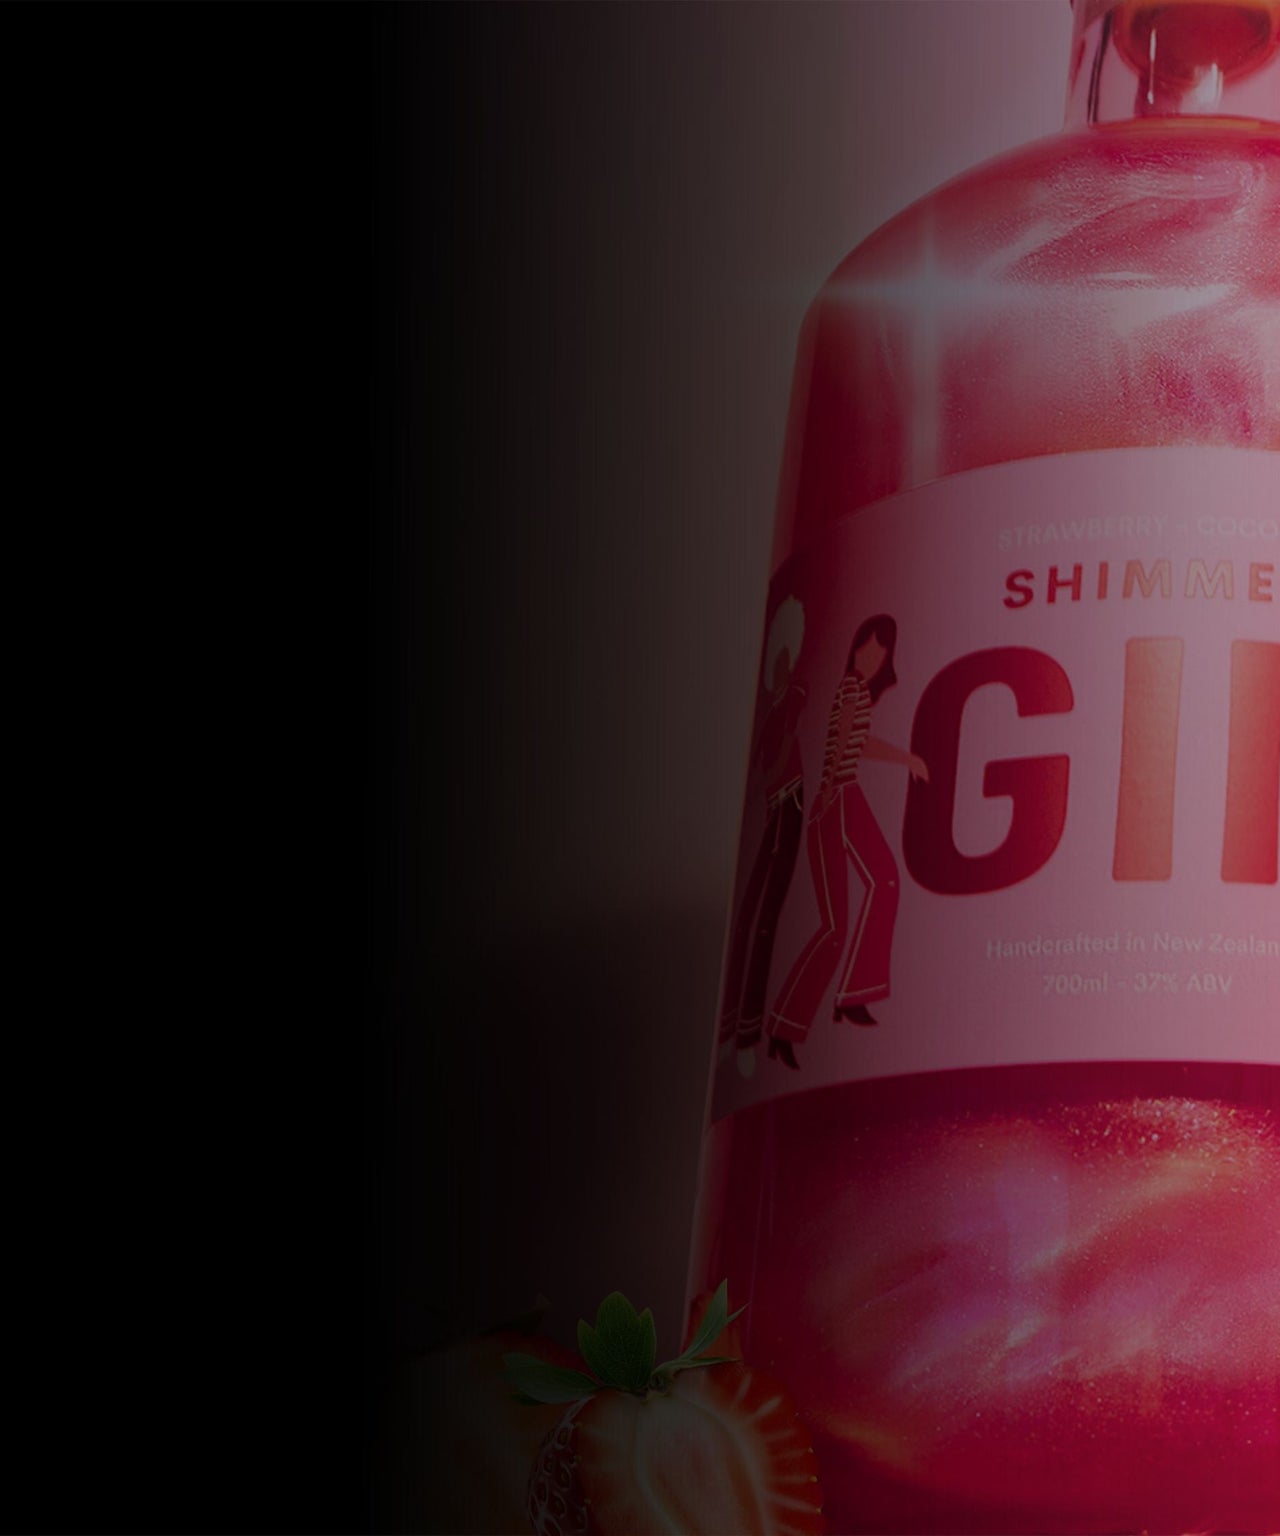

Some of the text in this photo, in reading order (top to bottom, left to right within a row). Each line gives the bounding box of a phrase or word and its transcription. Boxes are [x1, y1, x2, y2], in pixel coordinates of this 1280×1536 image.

[999, 514, 1168, 549] STRAWBERRY
[987, 931, 1118, 959] Handcrafted
[1125, 931, 1146, 952] in
[1153, 932, 1201, 953] New
[1042, 971, 1108, 996] 700ml
[1134, 971, 1180, 994] 37%
[1188, 973, 1232, 995] ABV
